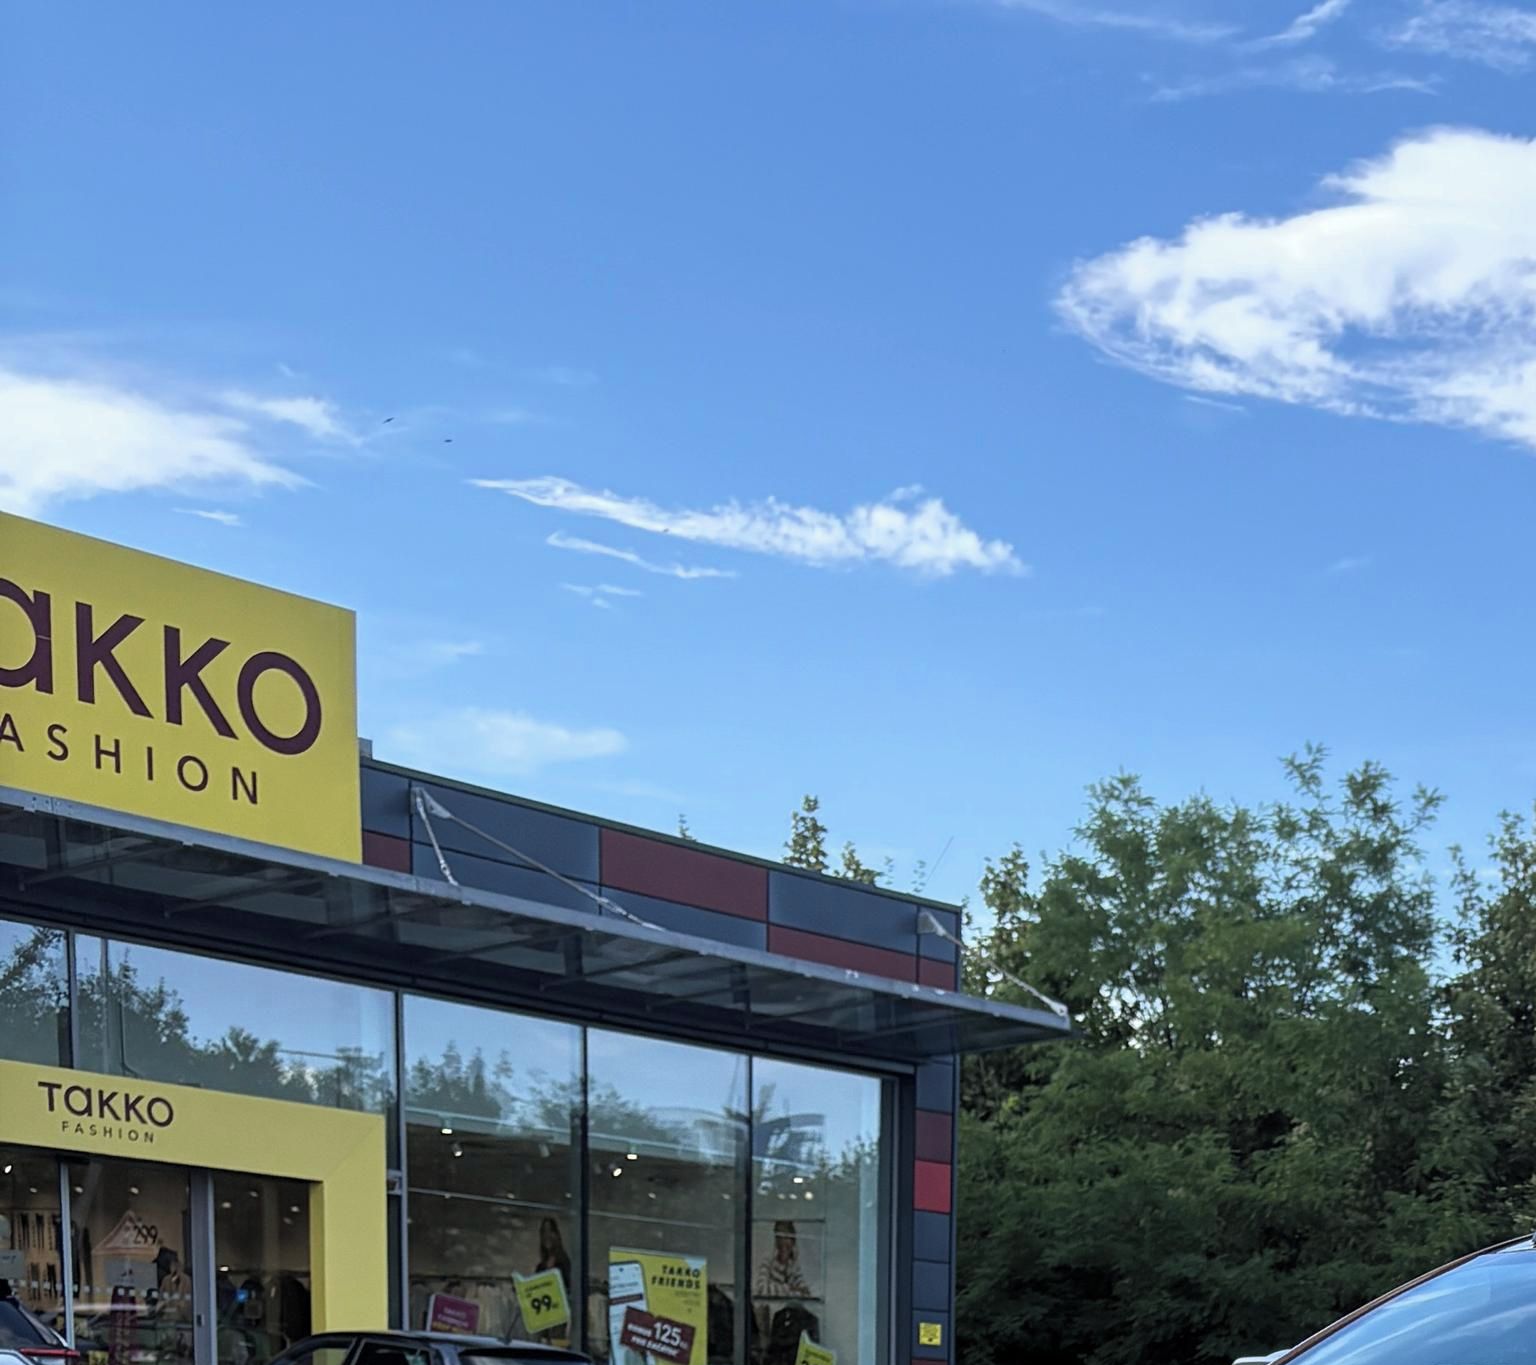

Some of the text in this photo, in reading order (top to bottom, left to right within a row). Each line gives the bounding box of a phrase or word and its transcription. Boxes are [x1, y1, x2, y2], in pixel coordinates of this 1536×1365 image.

[61, 1121, 154, 1143] FASHION
[651, 1275, 700, 1290] FRIENDS
[530, 1294, 552, 1316] 99
[653, 1321, 683, 1347] 125
